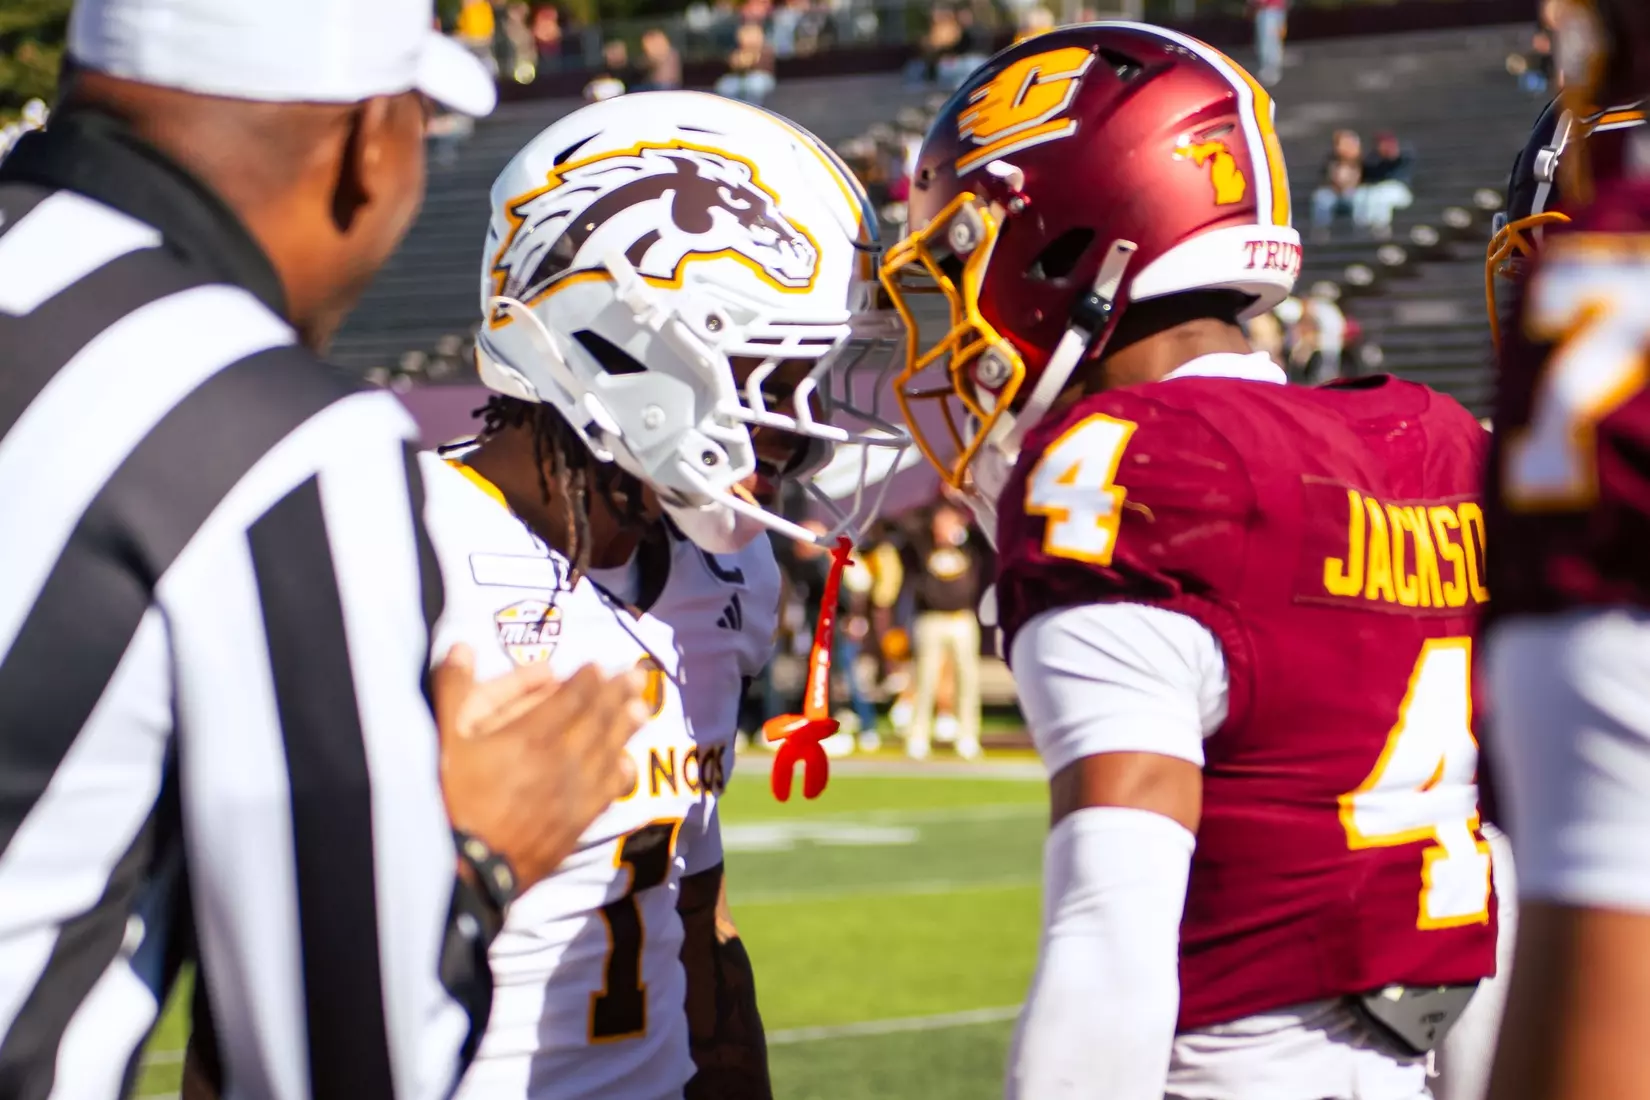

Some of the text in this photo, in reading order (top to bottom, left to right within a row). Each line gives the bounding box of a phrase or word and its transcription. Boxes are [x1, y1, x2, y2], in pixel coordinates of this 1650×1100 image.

[1024, 412, 1139, 567] 4
[1504, 234, 1650, 510] 7
[1337, 636, 1492, 930] 4
[587, 817, 684, 1045] 1
